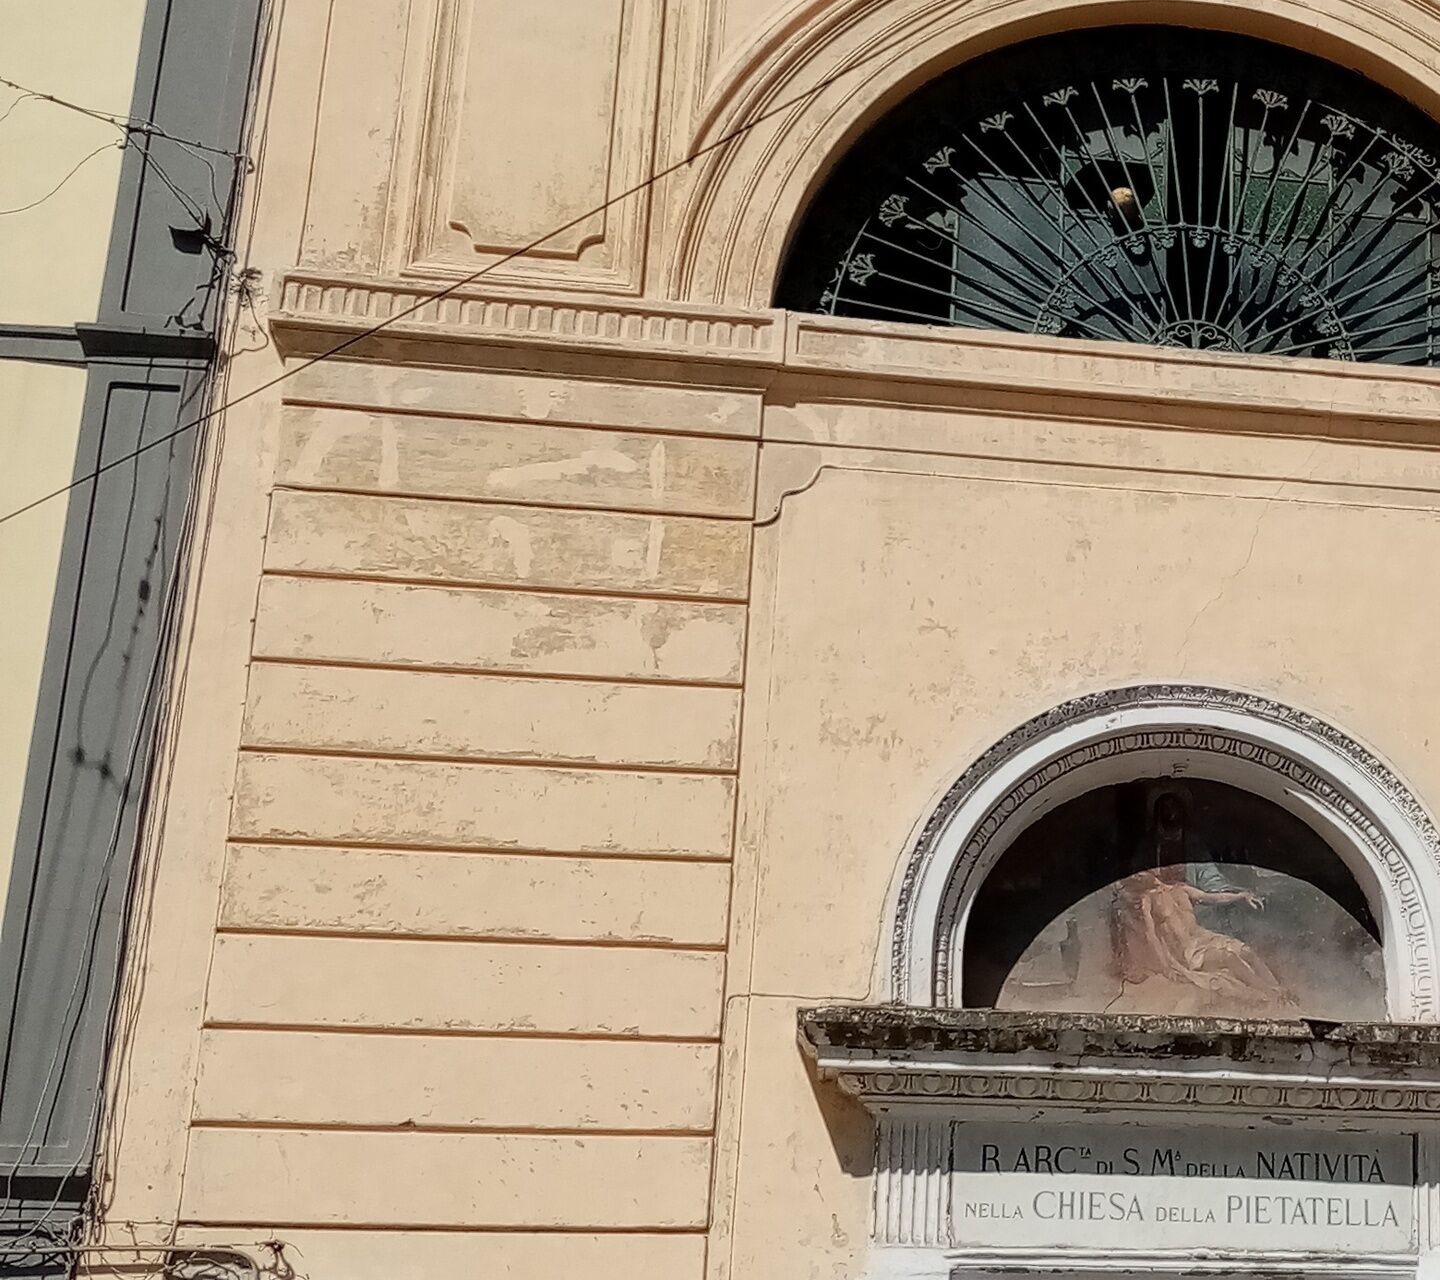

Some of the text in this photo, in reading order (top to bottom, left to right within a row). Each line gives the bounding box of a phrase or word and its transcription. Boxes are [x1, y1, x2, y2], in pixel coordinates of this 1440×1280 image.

[1096, 1160, 1114, 1175] DI
[1185, 1163, 1247, 1179] DELLA
[965, 1191, 1400, 1228] NELLA CHIESA DELLA PIETATELLA
